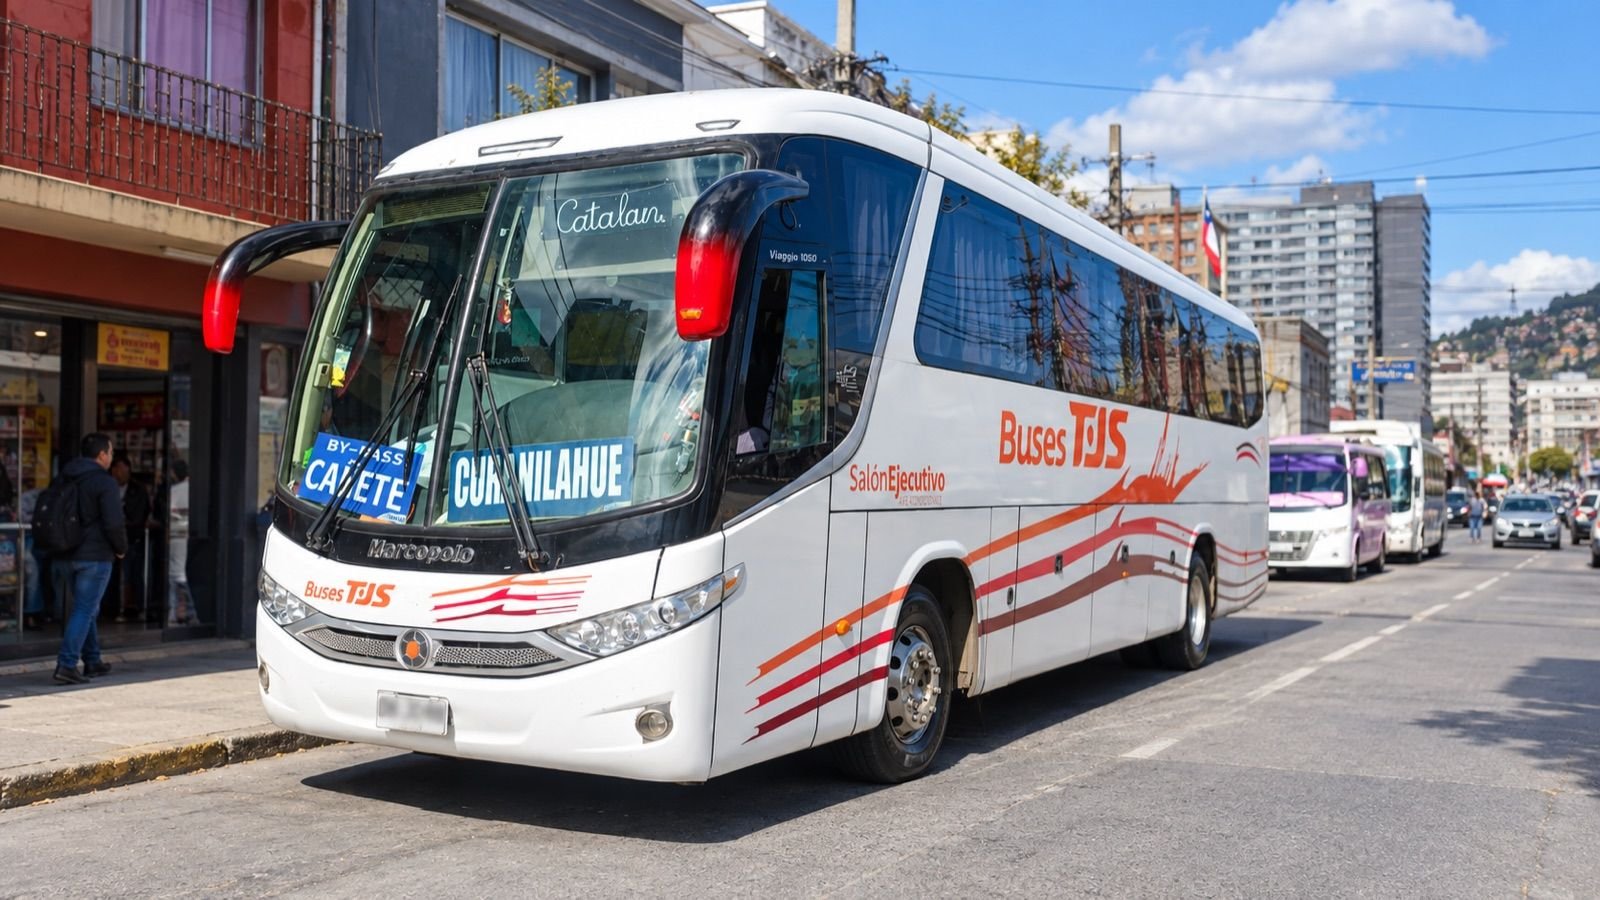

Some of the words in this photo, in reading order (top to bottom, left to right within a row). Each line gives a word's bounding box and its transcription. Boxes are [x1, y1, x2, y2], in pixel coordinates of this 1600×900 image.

[769, 249, 799, 262] Viaggio
[800, 253, 817, 262] 1050
[999, 410, 1066, 466] Buses
[1069, 401, 1128, 469] TJS
[367, 538, 475, 564] Marcopolo
[304, 580, 344, 601] Buses
[346, 580, 395, 607] TJS
